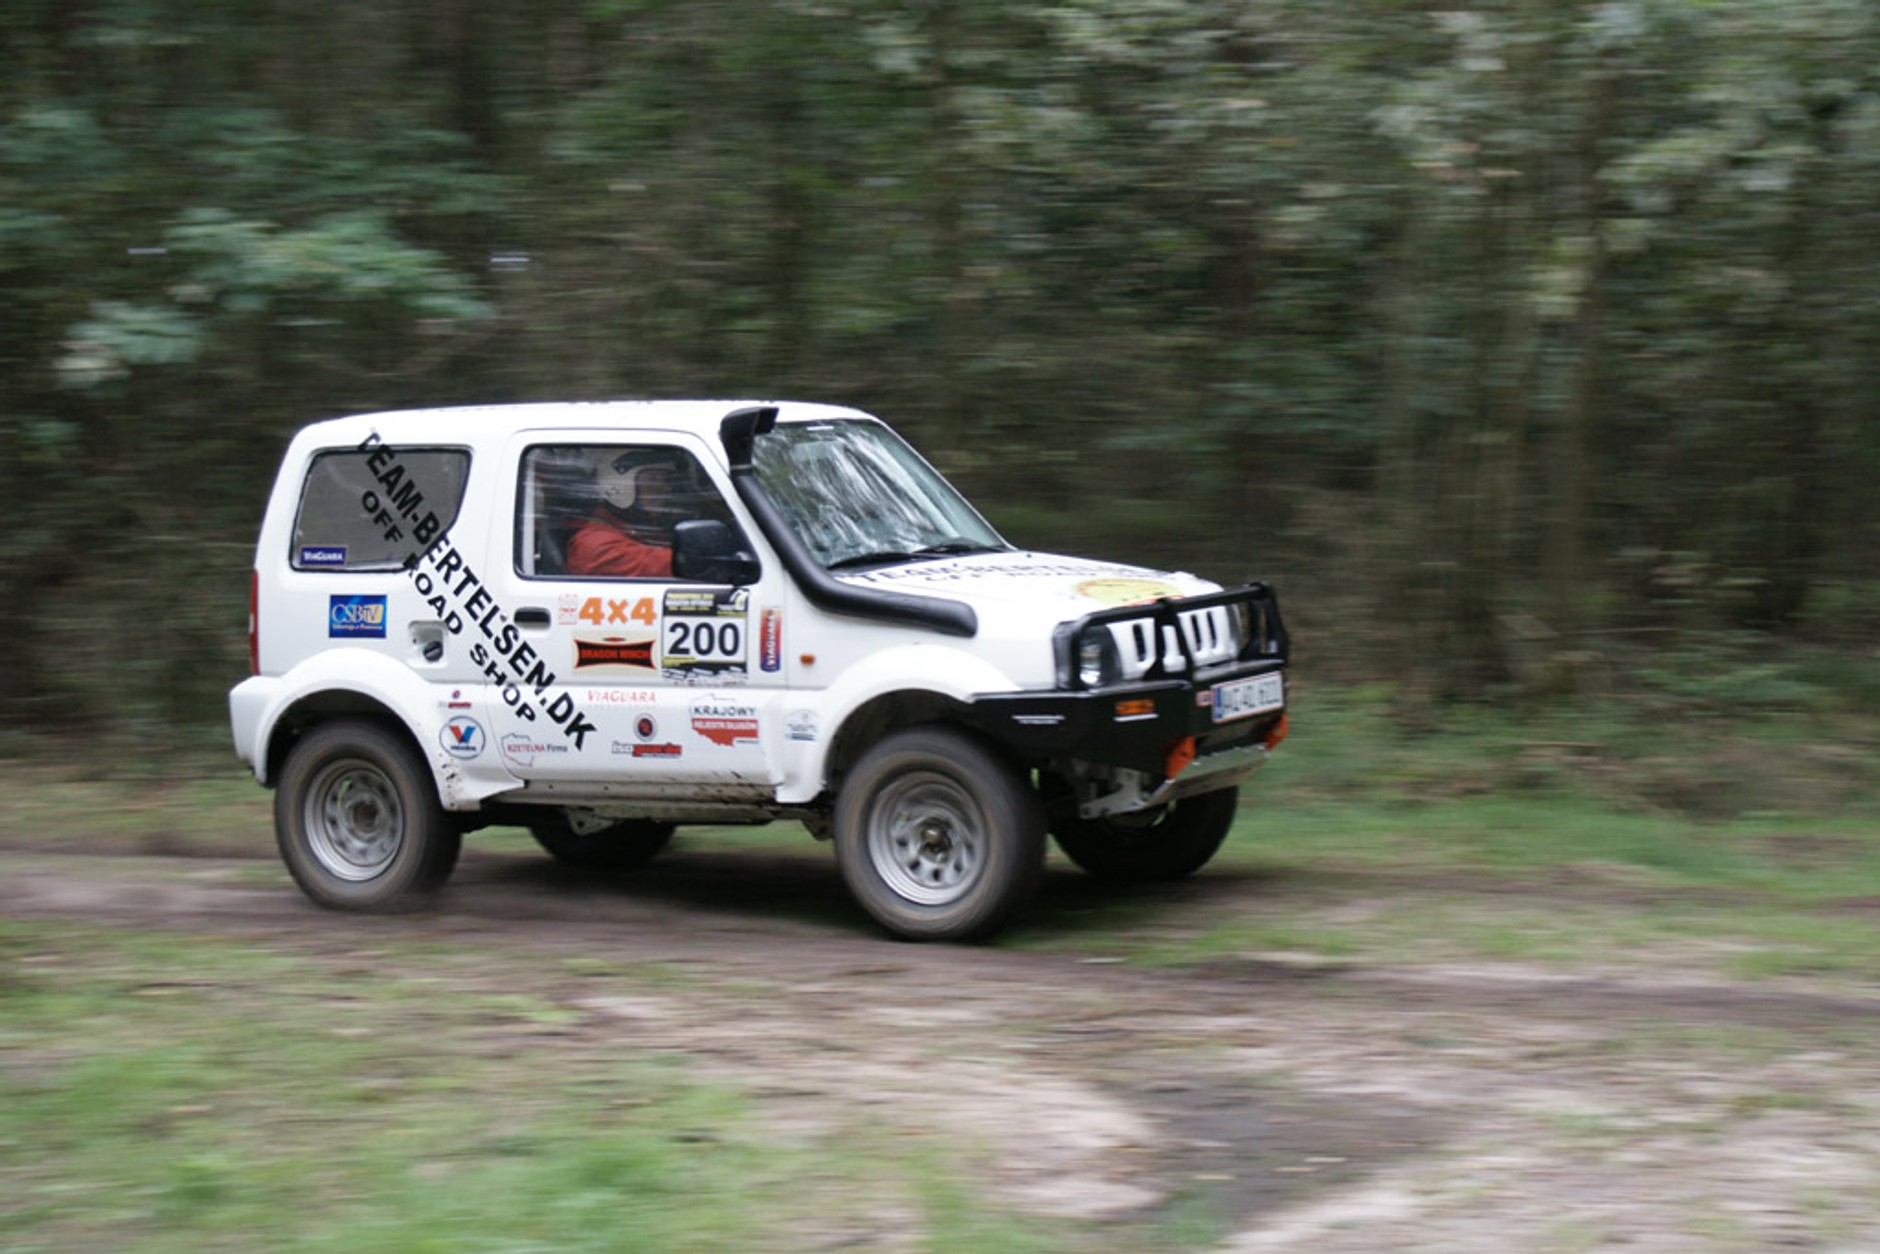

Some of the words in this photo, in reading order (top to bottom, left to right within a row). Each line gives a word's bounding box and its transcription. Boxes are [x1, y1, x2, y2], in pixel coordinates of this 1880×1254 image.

[361, 490, 404, 543] OFF
[402, 552, 464, 636] ROAD
[469, 642, 537, 723] SHOP
[667, 621, 740, 657] 200
[587, 690, 657, 703] VIAGUARA
[694, 705, 755, 717] KRAJOWY
